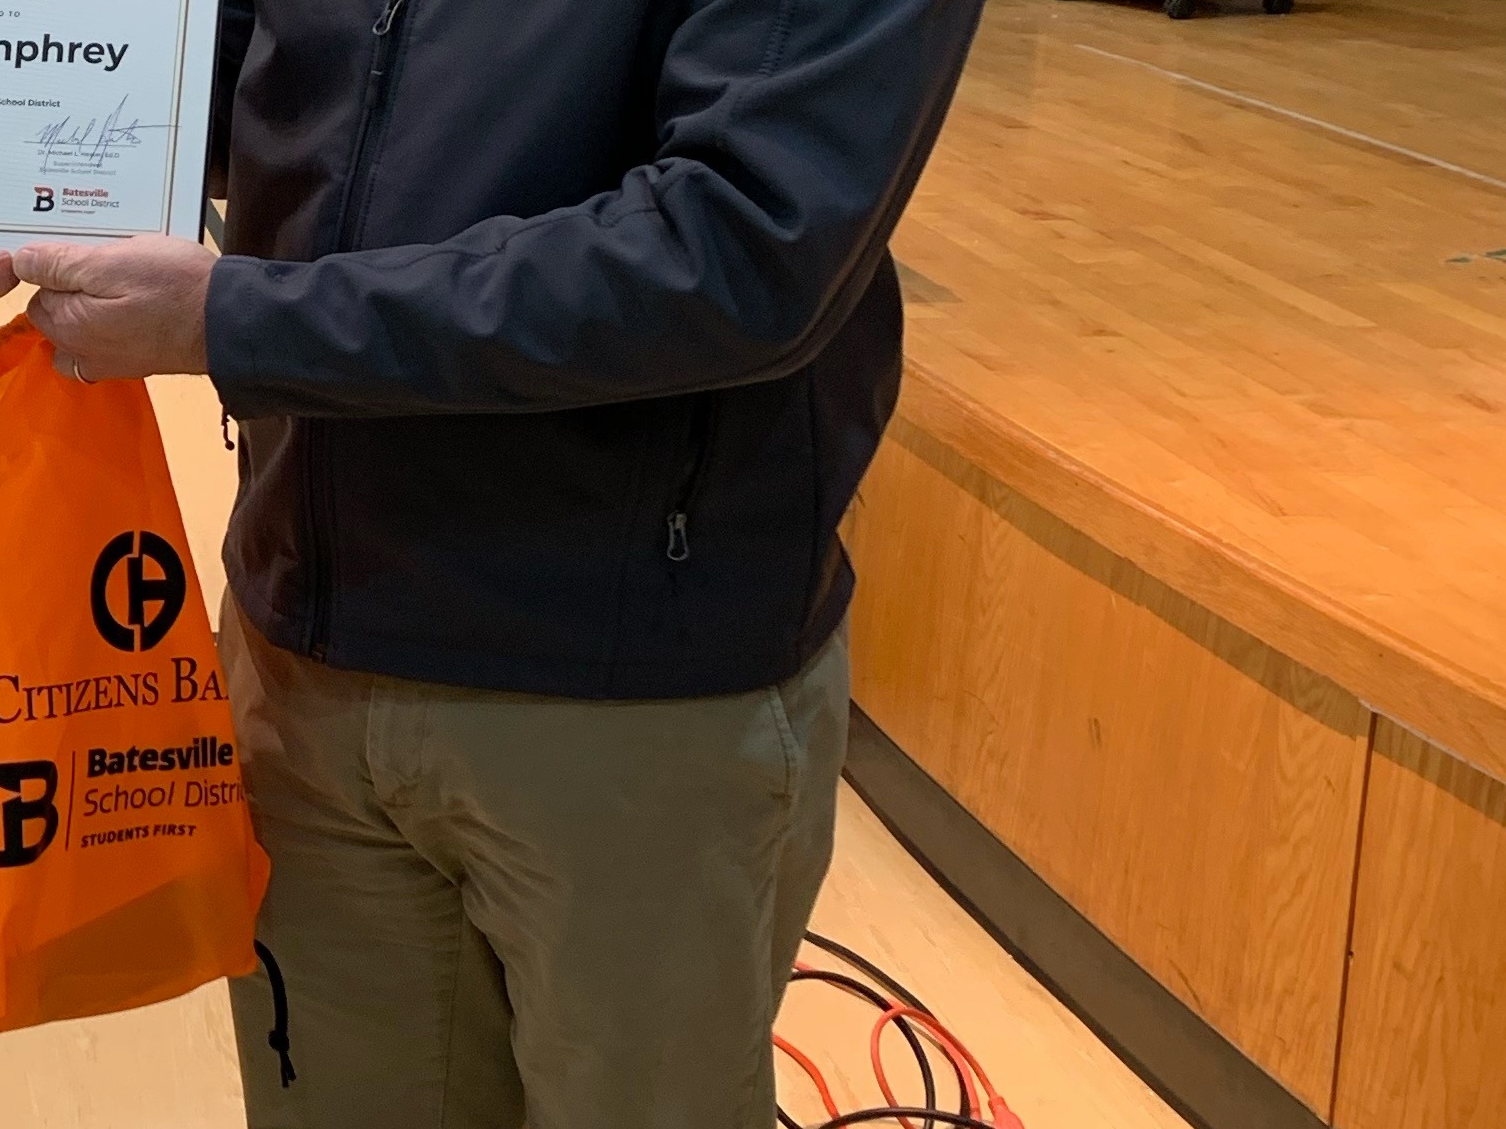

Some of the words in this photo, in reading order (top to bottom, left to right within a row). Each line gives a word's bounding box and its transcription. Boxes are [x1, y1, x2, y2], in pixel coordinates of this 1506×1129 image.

[8, 10, 21, 18] TO
[28, 99, 61, 108] District
[62, 188, 108, 198] Batesville
[62, 198, 89, 207] School
[91, 199, 120, 208] District
[171, 657, 229, 703] BA
[87, 736, 233, 777] Batesville
[83, 781, 175, 816] School
[184, 776, 244, 807] Distri
[81, 825, 149, 848] STUDENTS
[153, 824, 197, 837] FIRST
